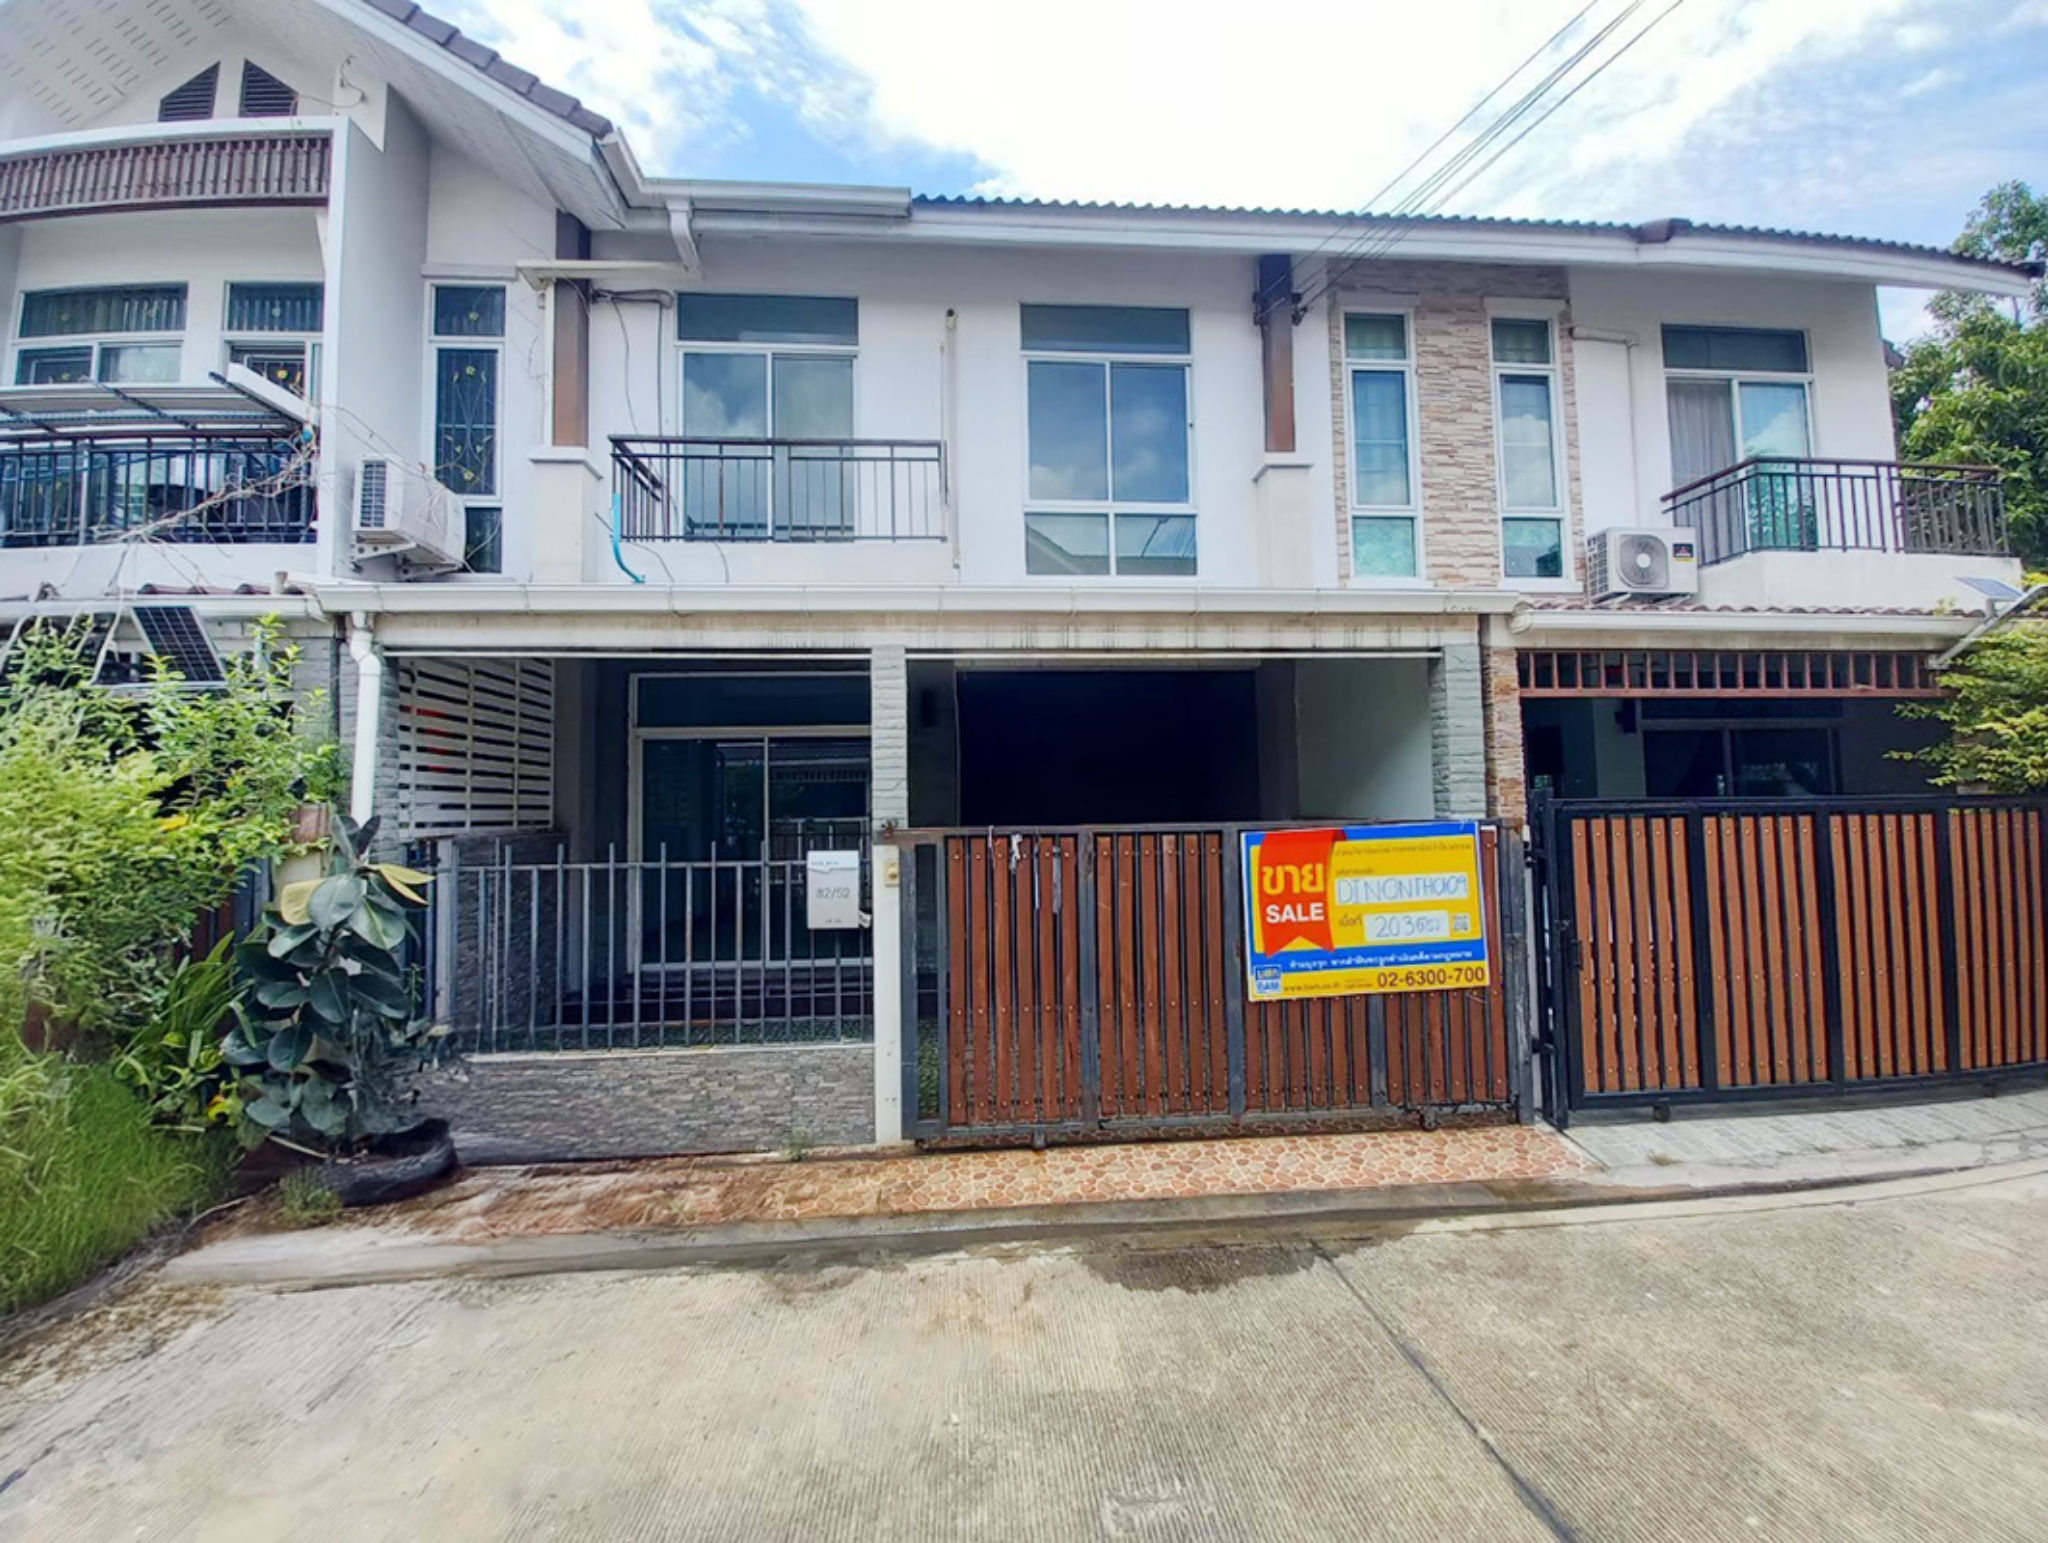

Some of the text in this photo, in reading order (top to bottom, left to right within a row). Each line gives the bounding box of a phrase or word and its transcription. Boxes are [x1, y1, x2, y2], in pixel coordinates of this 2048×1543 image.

[1262, 863, 1325, 895] ขาย
[816, 886, 851, 900] 82/52
[1265, 902, 1325, 924] SALE
[1377, 966, 1486, 988] 02-6300-700
